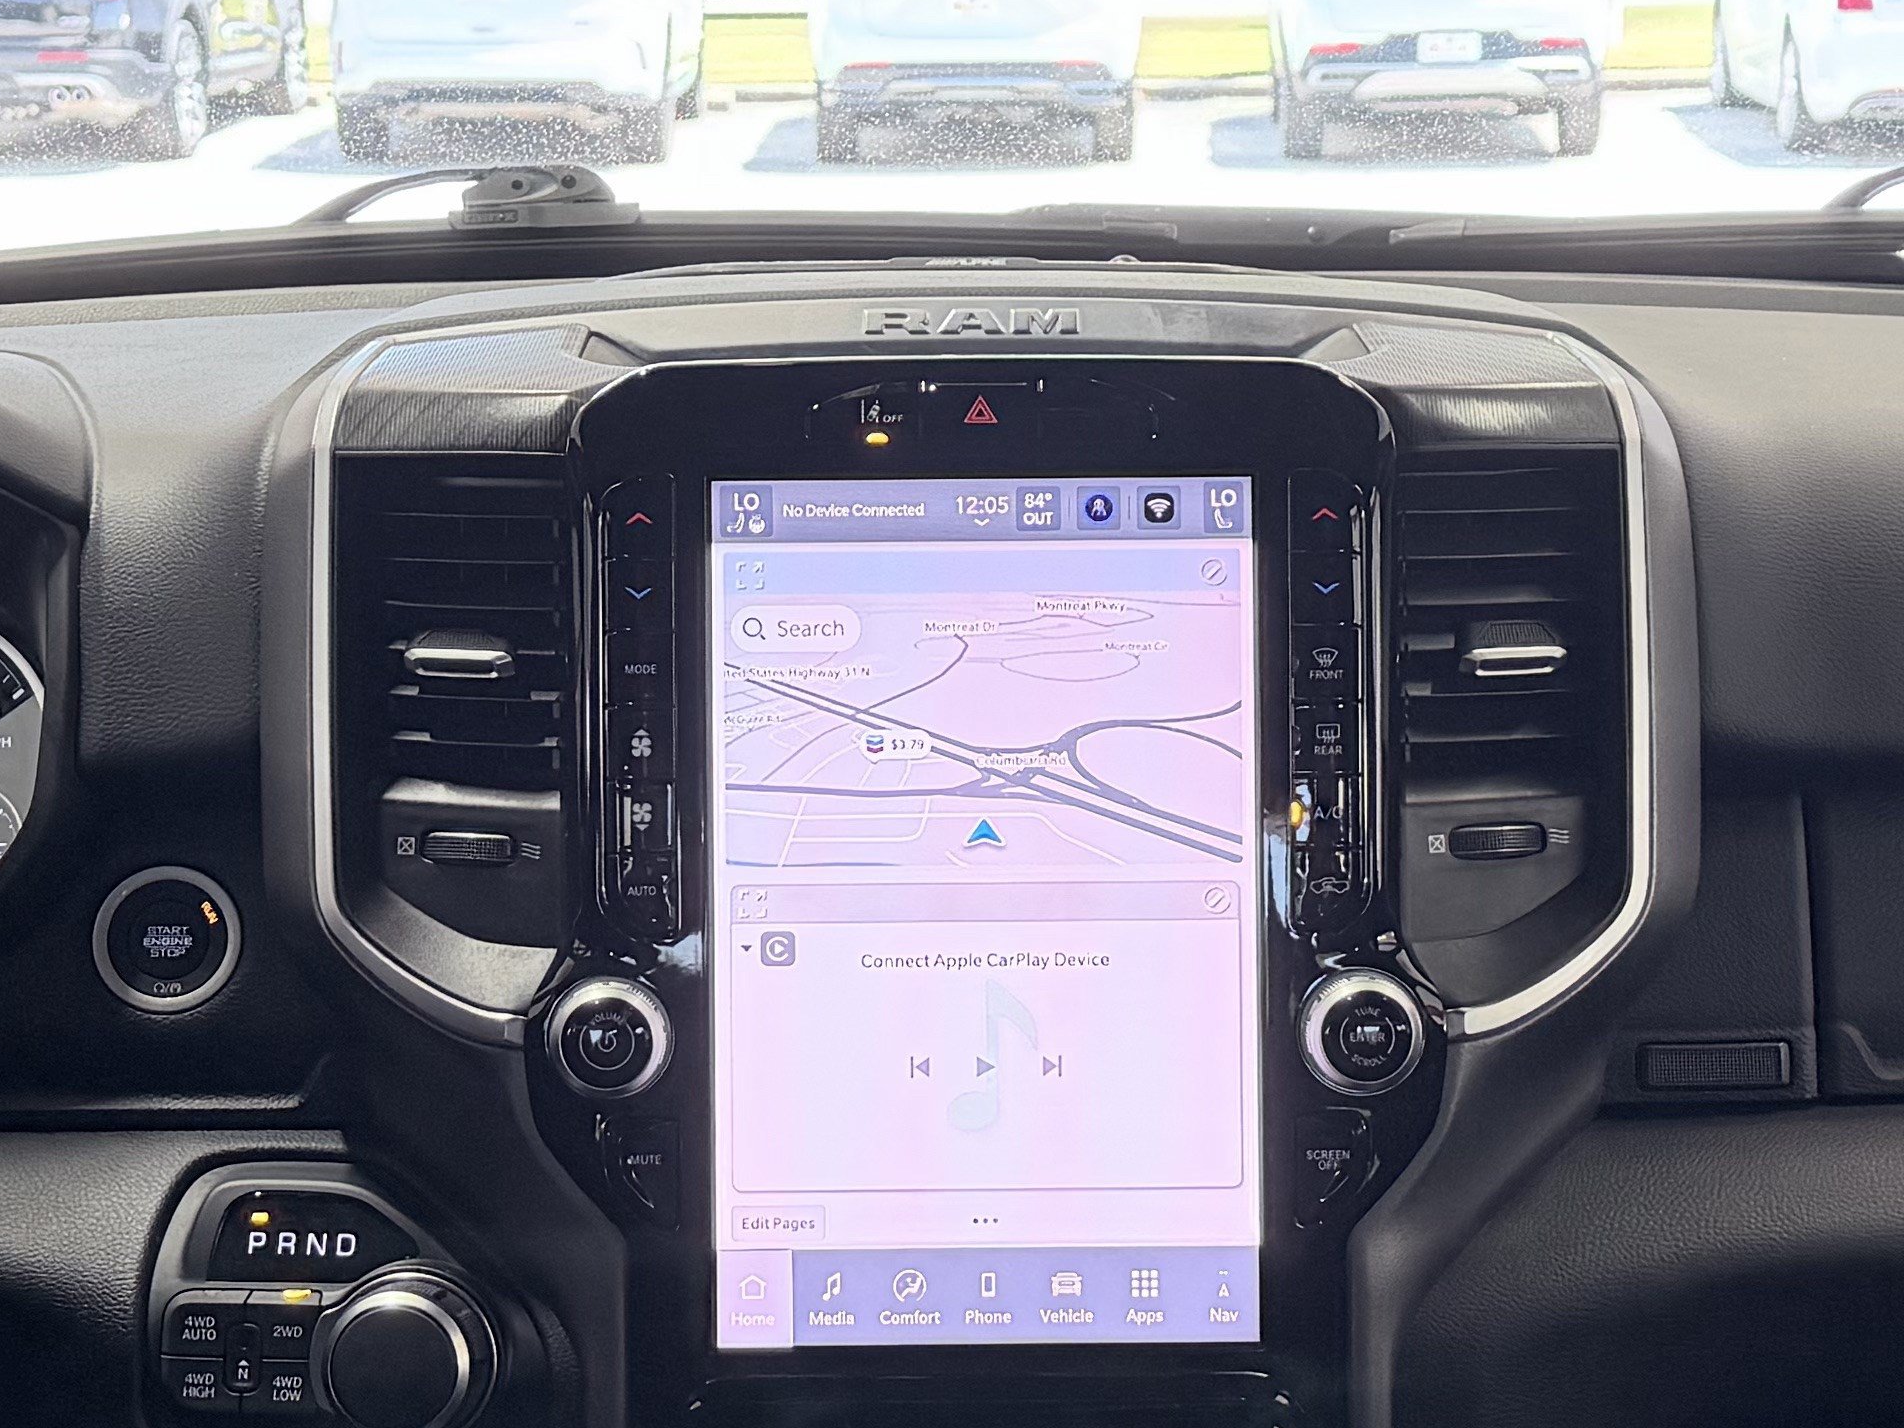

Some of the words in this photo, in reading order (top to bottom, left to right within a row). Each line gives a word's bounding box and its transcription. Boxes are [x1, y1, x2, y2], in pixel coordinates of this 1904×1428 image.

[861, 307, 1081, 335] RAM
[883, 413, 904, 424] OFF
[733, 491, 760, 512] LO
[1024, 492, 1054, 509] 84°
[1210, 488, 1238, 509] LO
[782, 502, 803, 518] No
[805, 502, 851, 518] Device
[853, 501, 926, 518] Connected
[955, 496, 1010, 516] 12:05
[1023, 511, 1055, 527] OUT
[777, 618, 846, 639] Search
[624, 664, 657, 675] MODE
[1309, 669, 1344, 680] FRONT
[1314, 745, 1343, 756] REAR
[1313, 805, 1343, 820] A/C
[627, 885, 657, 897] AUTO
[147, 926, 190, 935] START
[142, 937, 193, 947] ENGINE
[149, 948, 186, 958] STOP
[860, 951, 932, 970] Connect
[933, 951, 983, 972] Apple
[987, 951, 1050, 971] CarPlay
[1053, 950, 1111, 969] Device
[1353, 1006, 1381, 1019] TUNE
[1349, 1031, 1386, 1042] ENTER
[1351, 1053, 1387, 1068] SCROLL
[629, 1154, 662, 1166] MUTE
[1306, 1149, 1351, 1161] SCREEN
[1318, 1159, 1339, 1171] OFF
[741, 1215, 772, 1232] Edit
[773, 1216, 816, 1234] Pages
[731, 1311, 775, 1326] Home
[808, 1310, 855, 1326] Media
[879, 1309, 941, 1326] Comfort
[964, 1309, 1012, 1325] Phone
[1040, 1308, 1094, 1324] Vehicle
[1126, 1308, 1164, 1326] Apps
[1209, 1307, 1239, 1323] Nav
[184, 1316, 215, 1329] 4WD
[182, 1329, 217, 1341] AUTO
[272, 1325, 303, 1338] 2WD
[184, 1373, 215, 1385] 4WD
[237, 1367, 249, 1380] N
[272, 1376, 302, 1388] 4WD
[182, 1386, 215, 1399] HIGH
[272, 1389, 302, 1402] LOW
